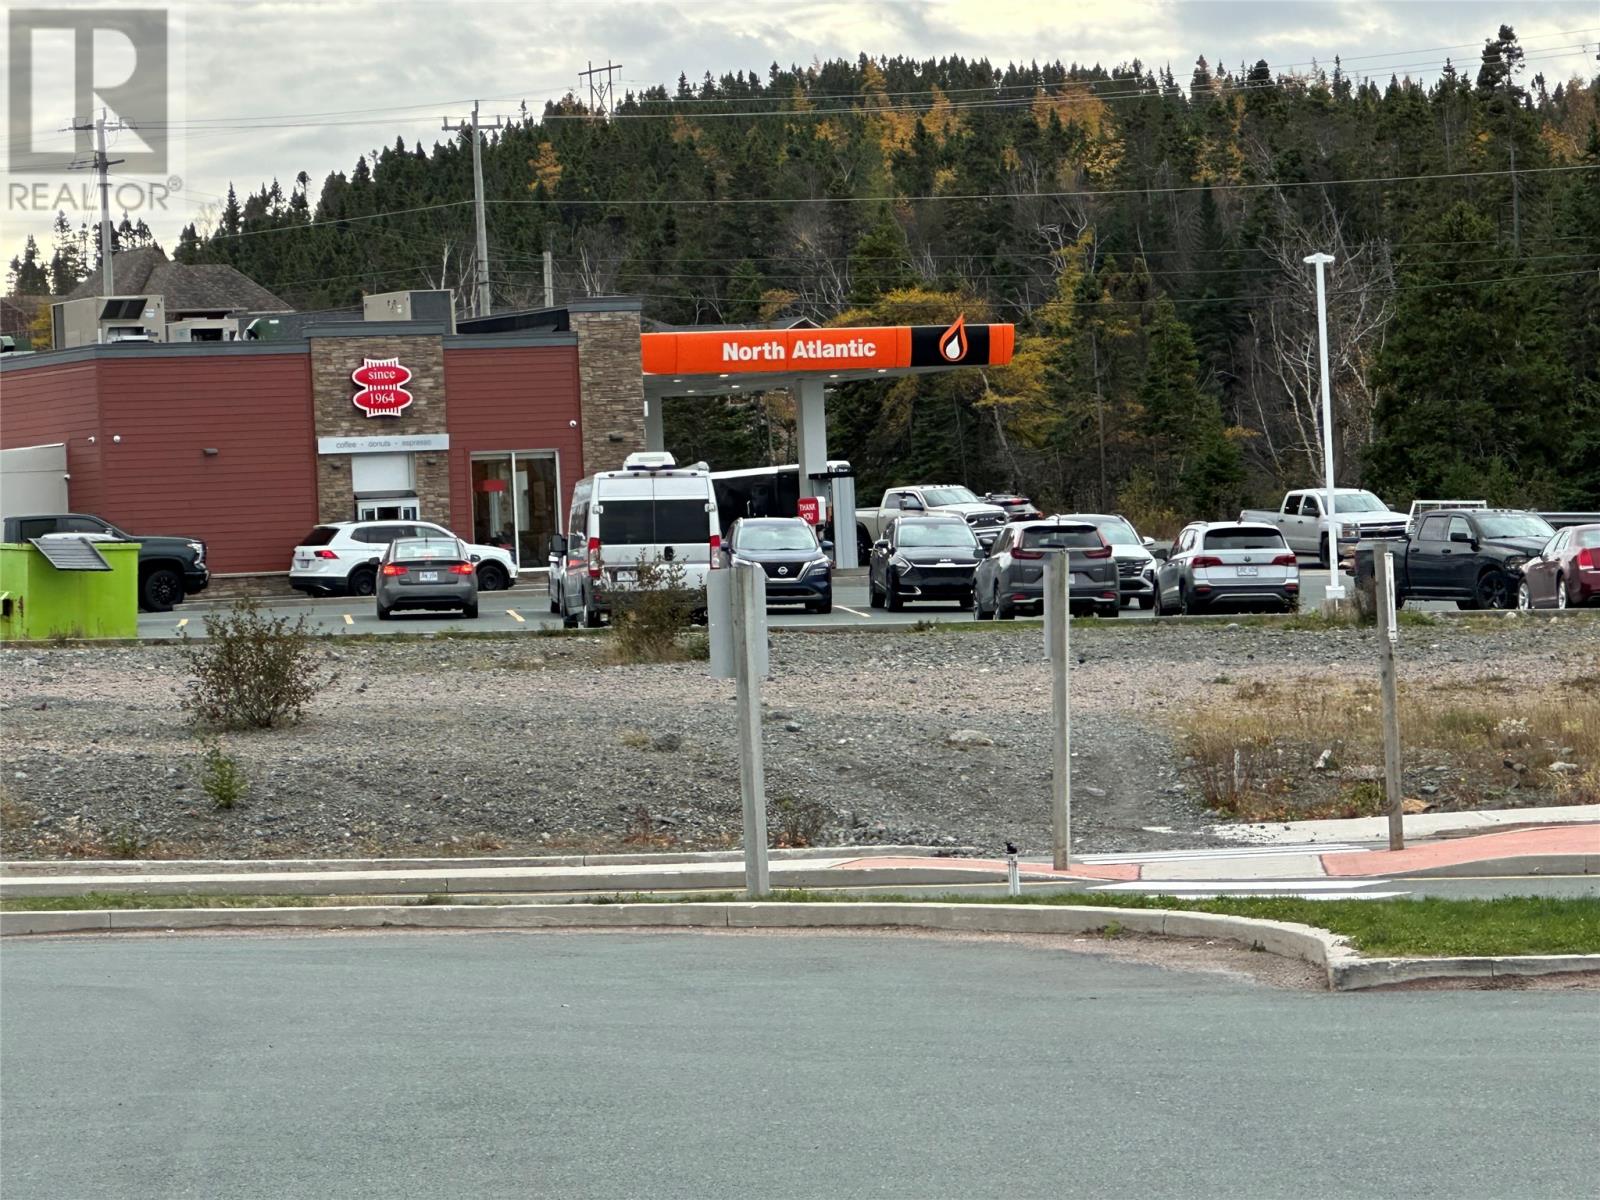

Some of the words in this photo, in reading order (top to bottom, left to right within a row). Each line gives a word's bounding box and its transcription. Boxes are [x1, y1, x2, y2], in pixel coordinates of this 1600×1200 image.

[722, 341, 785, 361] North
[791, 338, 877, 359] Atlantic
[368, 368, 396, 380] since
[370, 392, 395, 404] 1964
[336, 441, 357, 449] coffee
[799, 503, 816, 511] THANK
[802, 512, 814, 521] YOU
